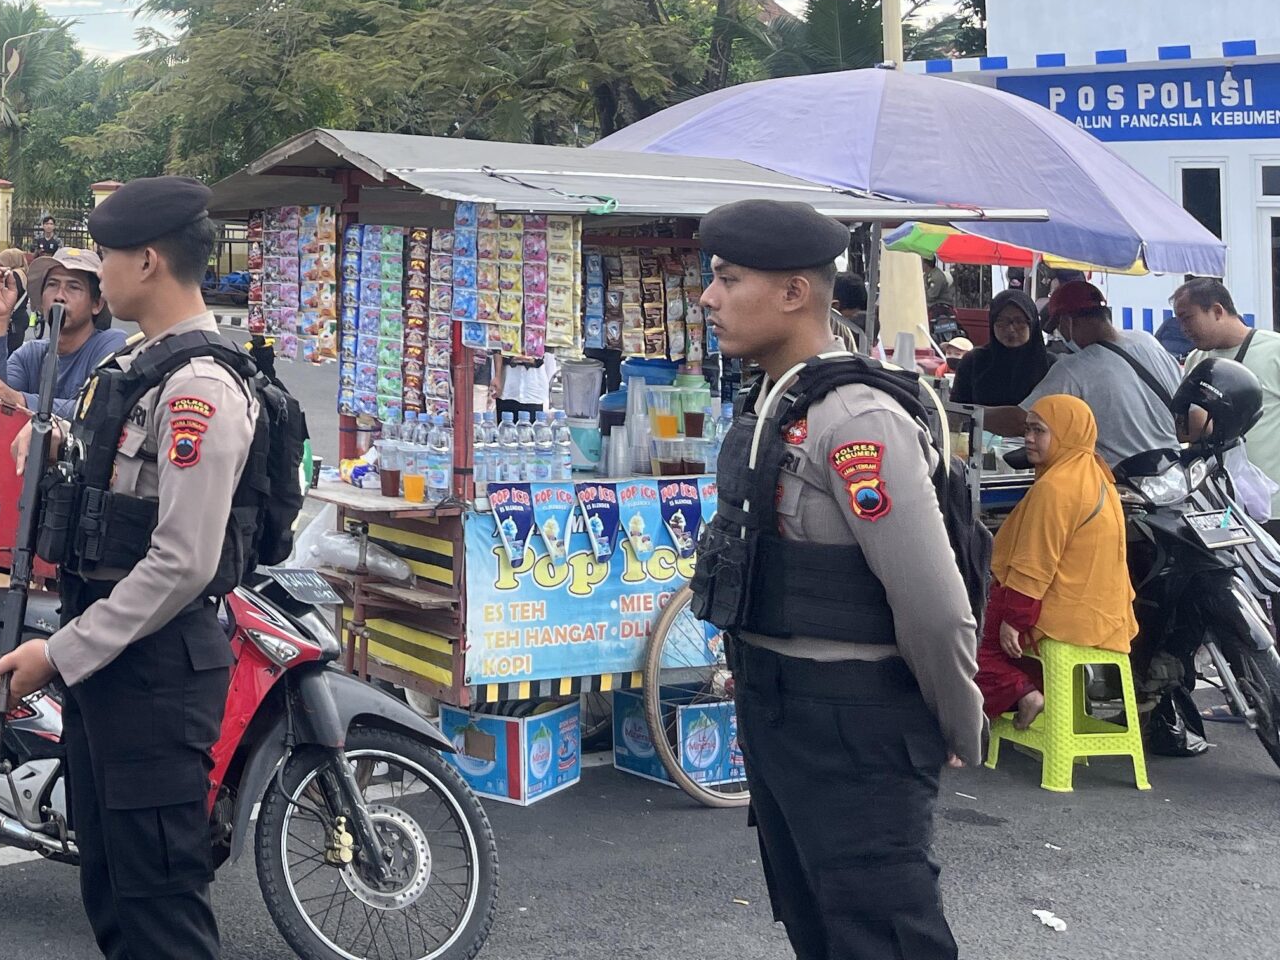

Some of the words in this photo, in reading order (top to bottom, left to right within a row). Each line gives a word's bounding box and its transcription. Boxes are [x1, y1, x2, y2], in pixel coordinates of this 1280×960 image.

[1049, 84, 1125, 112] POS
[1137, 78, 1253, 110] POLISI
[1075, 115, 1112, 129] ALUN
[1121, 113, 1202, 128] PANCASILA
[1200, 381, 1223, 398] HONDA
[834, 444, 875, 459] POLRES
[835, 450, 877, 465] KEBUMEN
[492, 545, 609, 596] Pop
[483, 605, 503, 622] ES
[510, 601, 545, 621] TEH
[620, 594, 653, 612] MIE
[483, 630, 519, 649] TEH
[524, 623, 607, 646] HANGAT
[482, 655, 531, 677] KOPI
